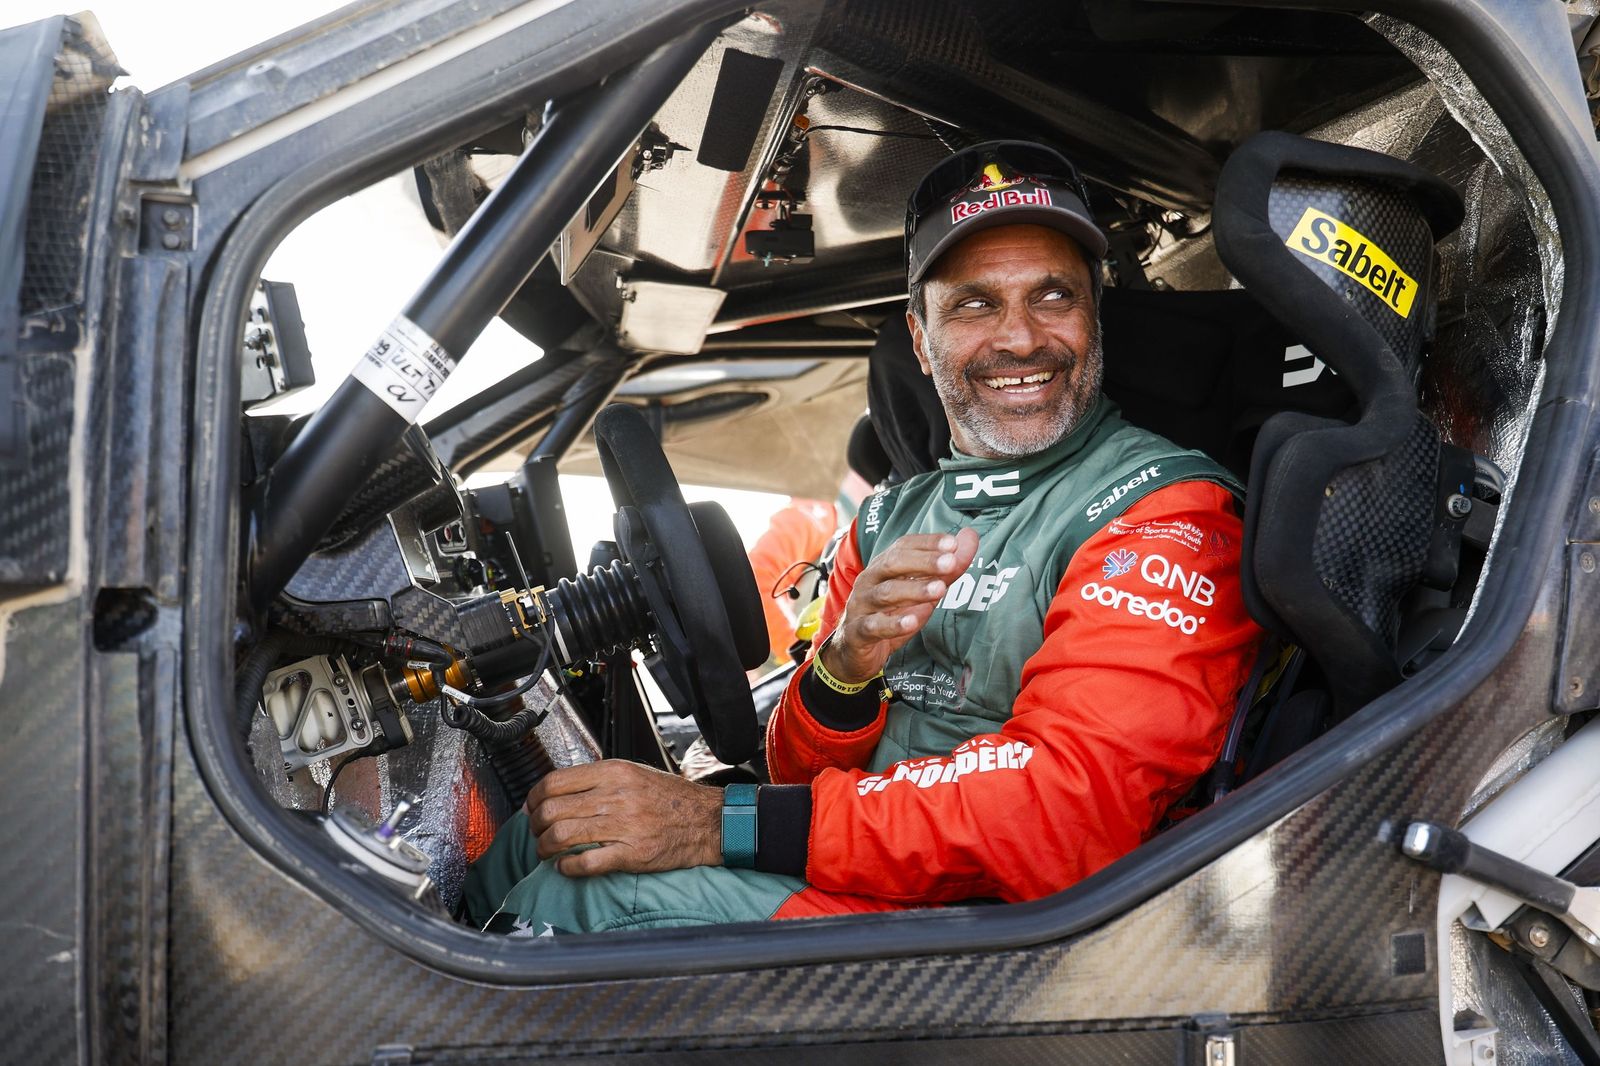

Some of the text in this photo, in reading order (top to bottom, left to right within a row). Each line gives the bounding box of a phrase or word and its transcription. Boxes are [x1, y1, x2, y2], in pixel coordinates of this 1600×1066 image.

[951, 187, 1052, 224] Red Bull
[1301, 217, 1406, 308] Sabelt
[1086, 465, 1161, 522] Sabelt
[1135, 526, 1143, 534] of
[1144, 526, 1168, 535] Sports
[1169, 528, 1182, 536] and
[1183, 531, 1202, 546] Youth
[1140, 554, 1216, 607] QNB
[1080, 582, 1205, 635] ooredoo
